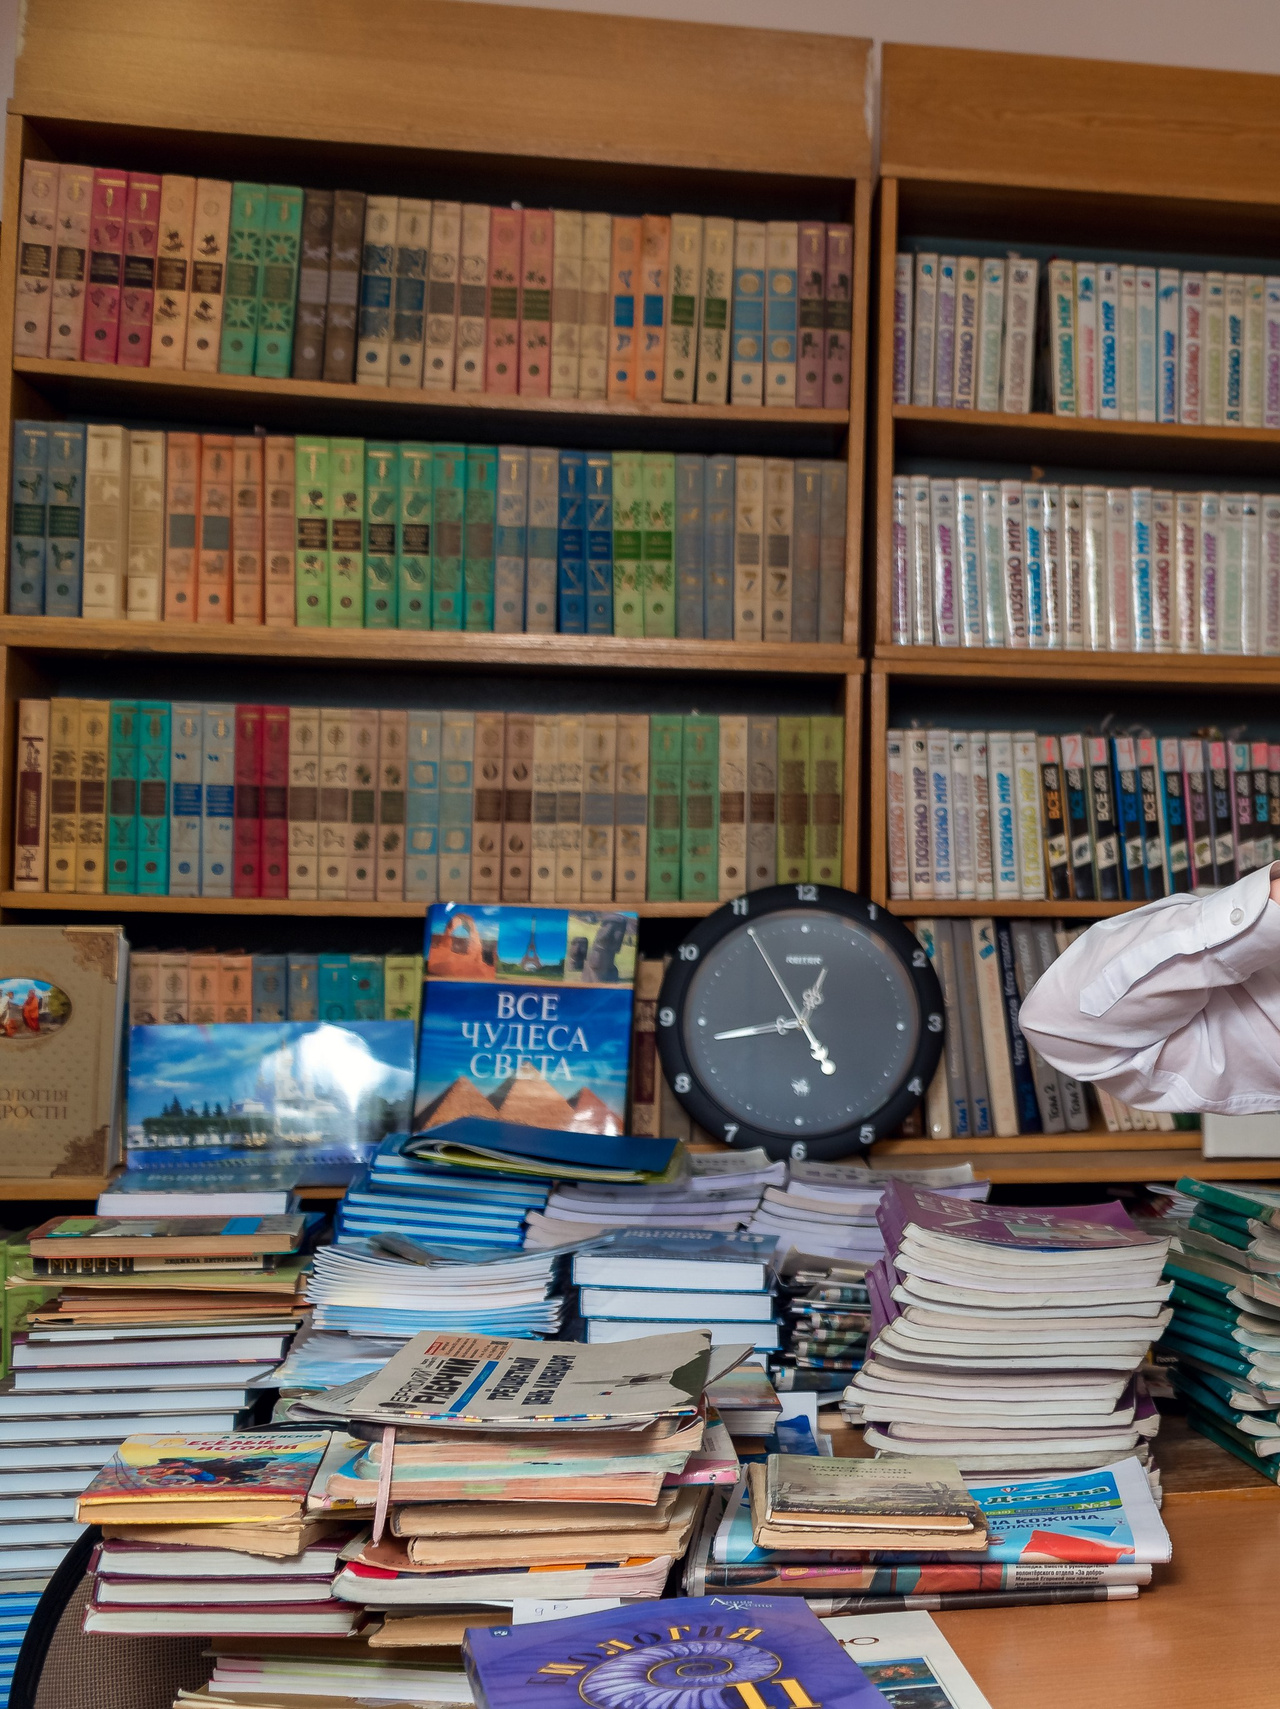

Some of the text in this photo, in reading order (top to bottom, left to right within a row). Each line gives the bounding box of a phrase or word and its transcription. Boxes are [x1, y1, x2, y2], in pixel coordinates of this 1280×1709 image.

[1044, 739, 1055, 762] 1
[1065, 738, 1083, 768] 2
[1093, 739, 1105, 762] 3
[1120, 739, 1135, 768] 4
[1141, 739, 1153, 763] 5
[1186, 741, 1200, 770] 7
[913, 766, 927, 800] МИР
[932, 772, 947, 804] МИР
[996, 772, 1011, 804] МИР
[1047, 792, 1060, 819] ВСЕ
[1095, 793, 1109, 821] ВСЕ
[1143, 793, 1157, 822] ВСЕ
[914, 804, 929, 868] ПОЗНАЮ
[934, 807, 950, 868] ПОЗНАЮ
[998, 807, 1014, 867] ПОЗНАЮ
[795, 885, 818, 901] 12
[731, 899, 747, 915] 11
[867, 904, 878, 921] 1
[678, 943, 700, 961] 10
[913, 951, 927, 968] 2
[497, 991, 560, 1021] ВСЕ
[659, 1007, 676, 1027] 9
[928, 1013, 943, 1032] 3
[461, 1021, 590, 1054] ЧУДЕСА
[469, 1052, 573, 1081] СВЕТА
[674, 1074, 692, 1093] 8
[907, 1076, 923, 1096] 4
[0, 1105, 67, 1119] РОСТИ
[724, 1122, 739, 1142] 7
[859, 1124, 876, 1144] 5
[791, 1142, 807, 1160] 6
[51, 1258, 76, 1271] MY
[411, 1358, 481, 1405] РАБОЧИЙ
[197, 1444, 299, 1452] ИСТОРИИ
[1016, 1514, 1105, 1525] КОЖИНА.
[526, 1624, 765, 1686] БИОЛОГИЯ
[724, 1676, 823, 1709] 11
